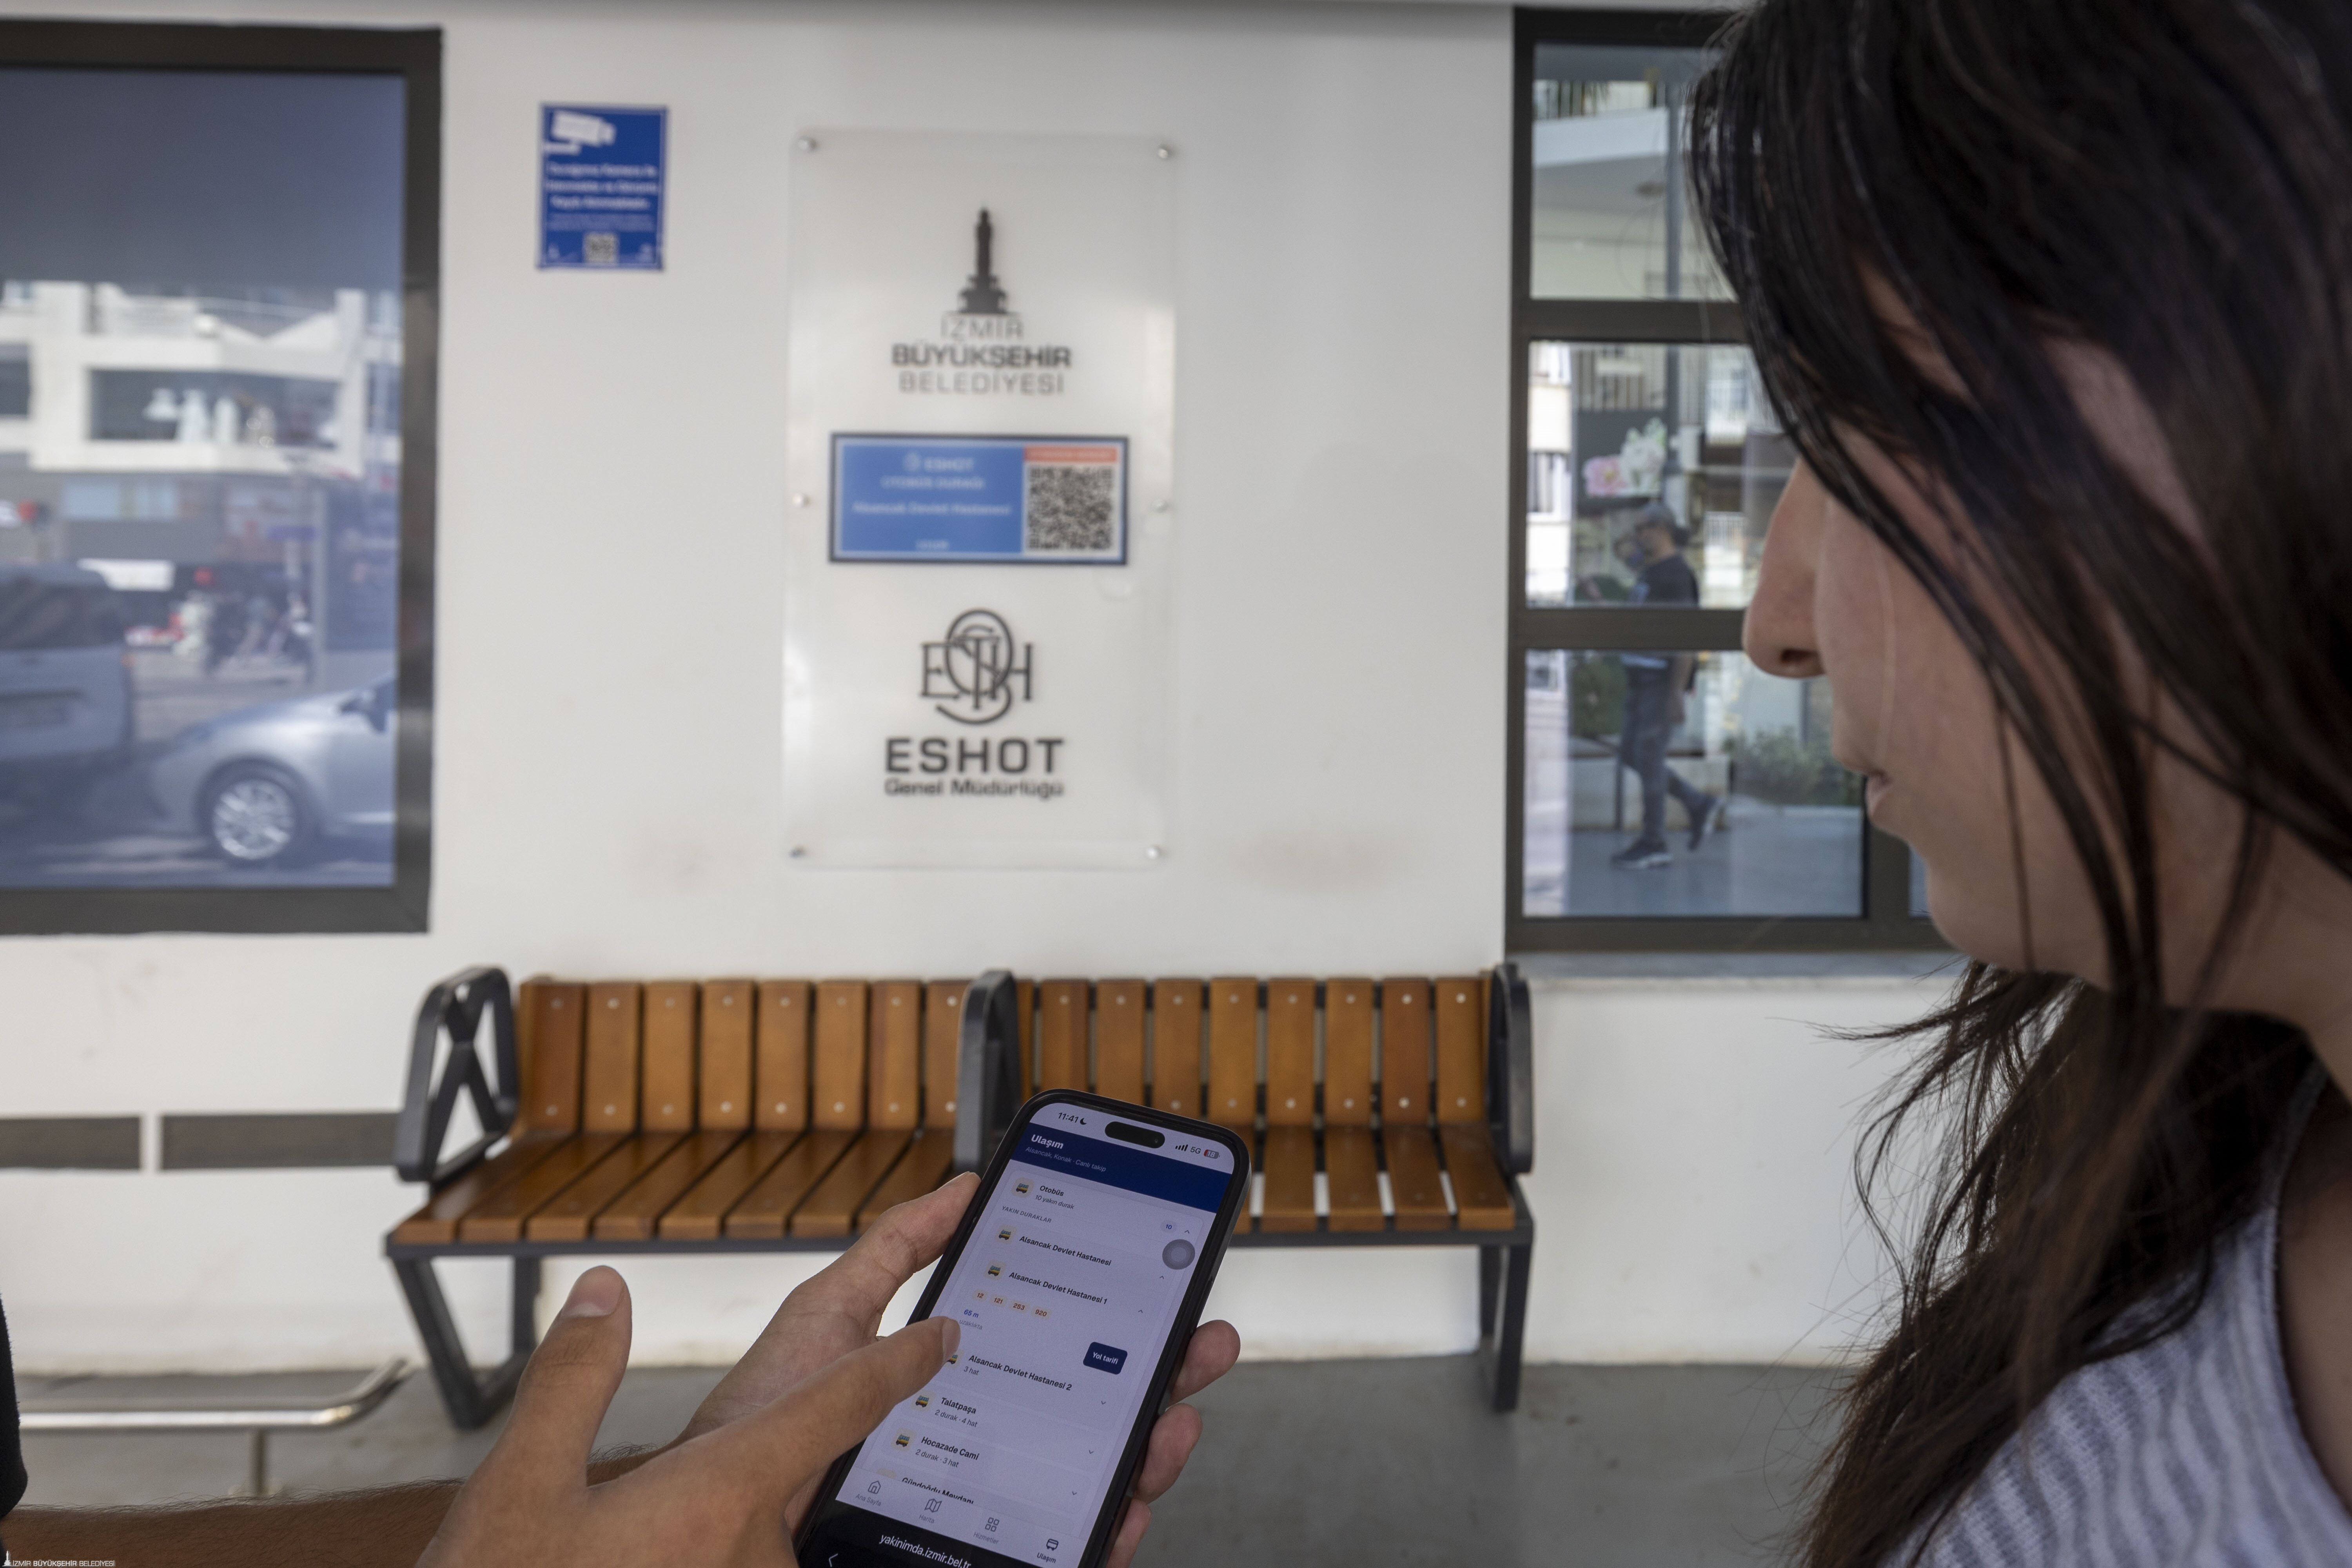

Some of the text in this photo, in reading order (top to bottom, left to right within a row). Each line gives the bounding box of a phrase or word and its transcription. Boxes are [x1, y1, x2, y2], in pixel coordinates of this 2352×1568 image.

[886, 738, 1064, 773] ESHOT
[884, 777, 1064, 800] Genel Müdürlüğü
[1058, 1112, 1079, 1123] 11:41
[1031, 1134, 1064, 1149] Ulaşım
[1025, 1147, 1107, 1172] Alsancak, Konak Canlı takip
[1040, 1185, 1064, 1196] Otobüs
[1058, 1201, 1075, 1210] durak
[1002, 1205, 1052, 1223] YAKIN DURAKLAR
[1019, 1236, 1112, 1266] Alsancak Devlet Hastanesi
[1009, 1272, 1042, 1286] Alsancak
[1042, 1281, 1066, 1293] Devlet
[1067, 1288, 1103, 1304] Hastanesi
[959, 1319, 983, 1330] uzaklıkta
[1093, 1352, 1118, 1365] Yol tarifi
[968, 1355, 1003, 1370] Alsancak
[1003, 1365, 1029, 1378] Devlet
[1028, 1373, 1066, 1390] Hastanesi
[969, 1367, 979, 1376] hat
[941, 1397, 976, 1414] Talatpaşa
[940, 1412, 958, 1421] durak
[921, 1436, 980, 1460] Hocazade Cami
[921, 1451, 939, 1461] durak
[948, 1459, 959, 1468] hat
[855, 1494, 882, 1507] Ana Sayfa
[918, 1514, 935, 1524] Harita
[973, 1532, 999, 1544] Hizmetler
[879, 1534, 972, 1568] yakinimda.izmir.bel.tr
[1037, 1552, 1056, 1564] Ulaşım
